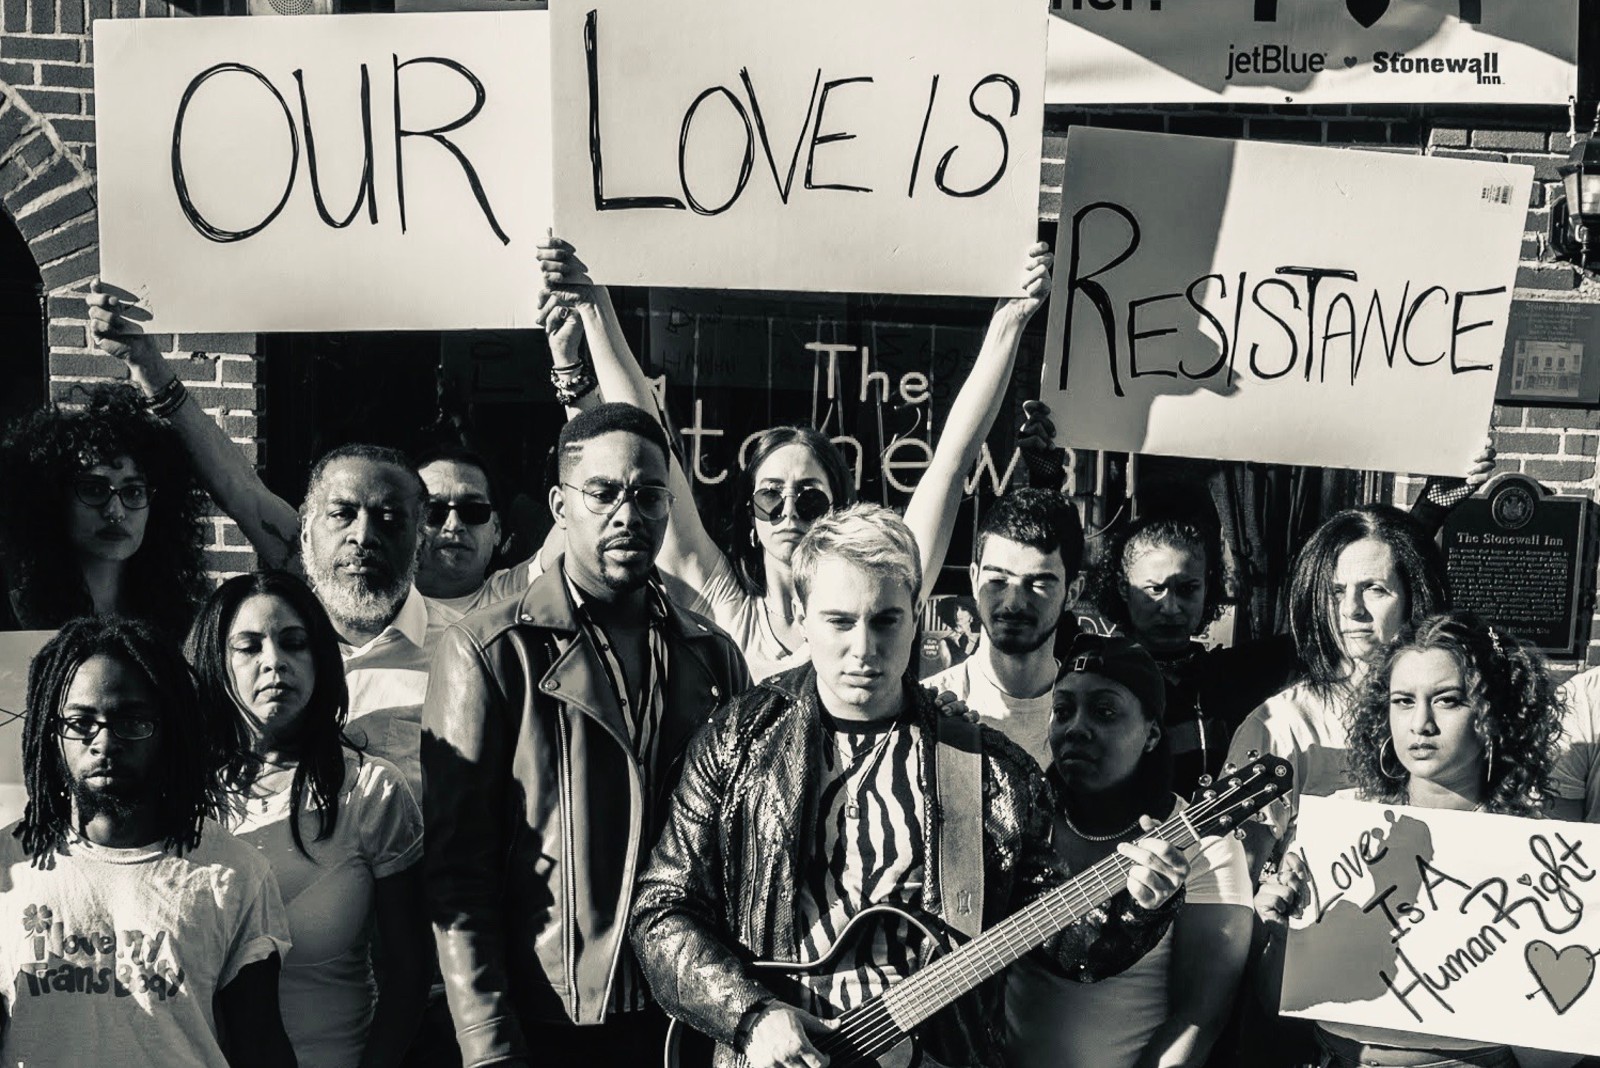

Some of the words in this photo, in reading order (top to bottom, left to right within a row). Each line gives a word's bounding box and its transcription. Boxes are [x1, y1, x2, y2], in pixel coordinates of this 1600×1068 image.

[1225, 44, 1325, 80] jetBlue
[1372, 51, 1499, 75] Stonewall
[1476, 70, 1503, 85] Inn
[171, 53, 510, 245] OUR
[584, 9, 874, 216] LOVE
[908, 73, 1020, 198] IS
[1059, 202, 1507, 397] RESISTANCE
[804, 342, 931, 404] The
[1457, 532, 1479, 543] The
[1483, 533, 1540, 545] Stonewall
[1544, 535, 1564, 546] Inn
[1300, 830, 1389, 924] Love
[1363, 885, 1426, 943] Is
[1415, 855, 1472, 911] A
[52, 921, 116, 959] love
[1379, 925, 1507, 1023] Human
[1459, 832, 1597, 935] Right
[20, 963, 112, 997] Trans
